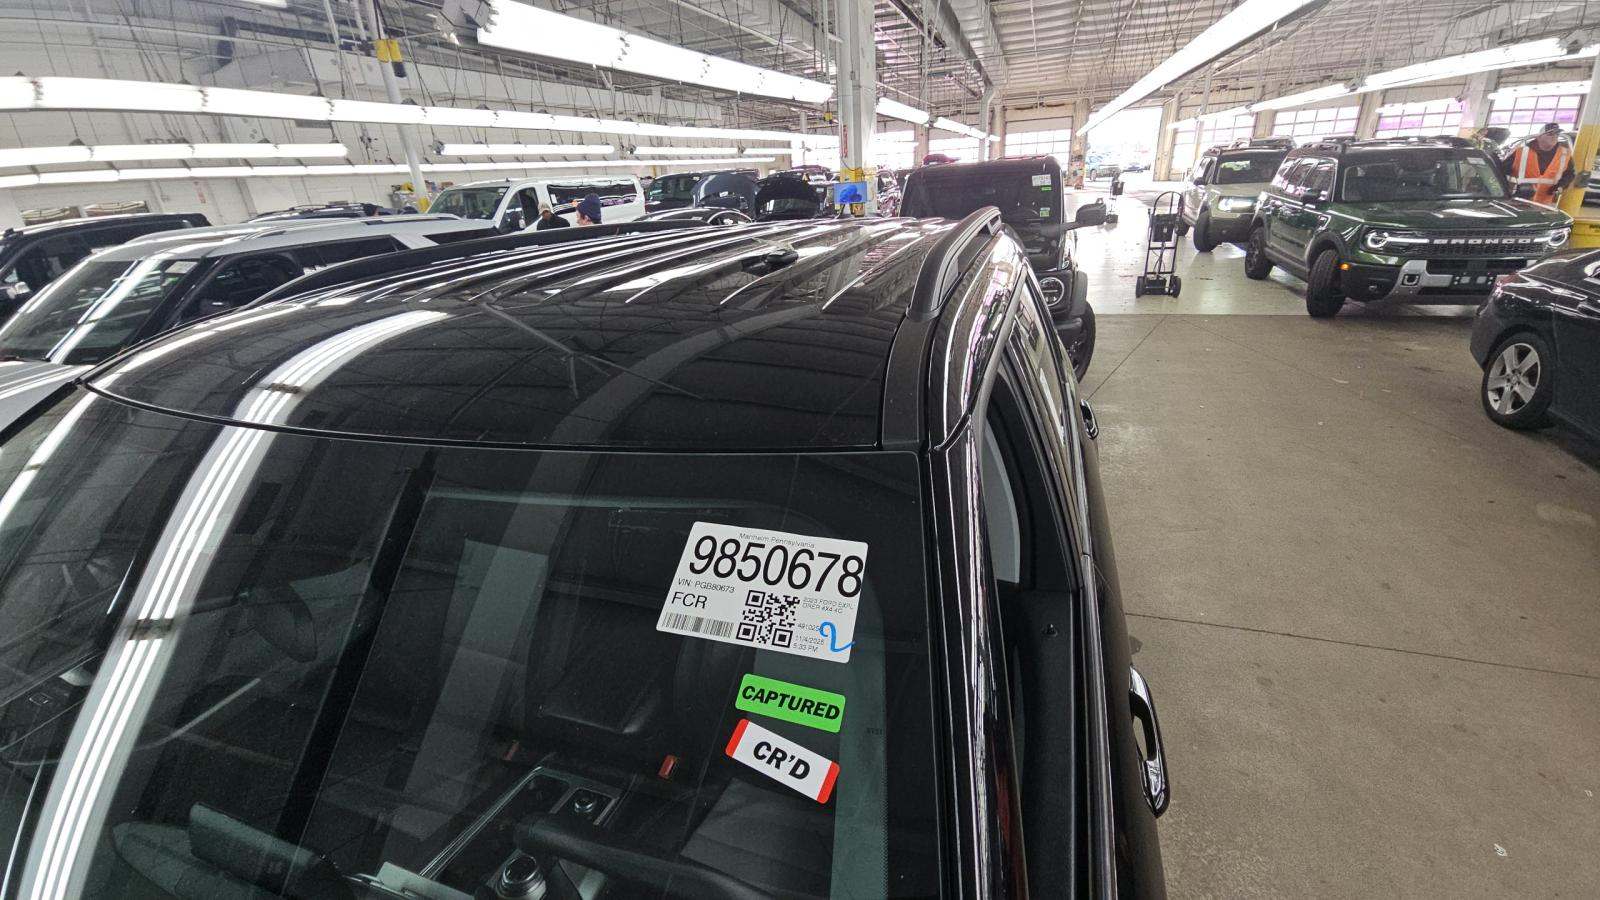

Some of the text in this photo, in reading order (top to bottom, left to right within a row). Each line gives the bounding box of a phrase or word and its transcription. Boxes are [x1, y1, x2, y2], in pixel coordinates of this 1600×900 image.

[689, 535, 863, 598] 9850678
[671, 591, 707, 609] FCR
[742, 686, 840, 720] CAPTURED
[753, 741, 810, 780] CR'D
